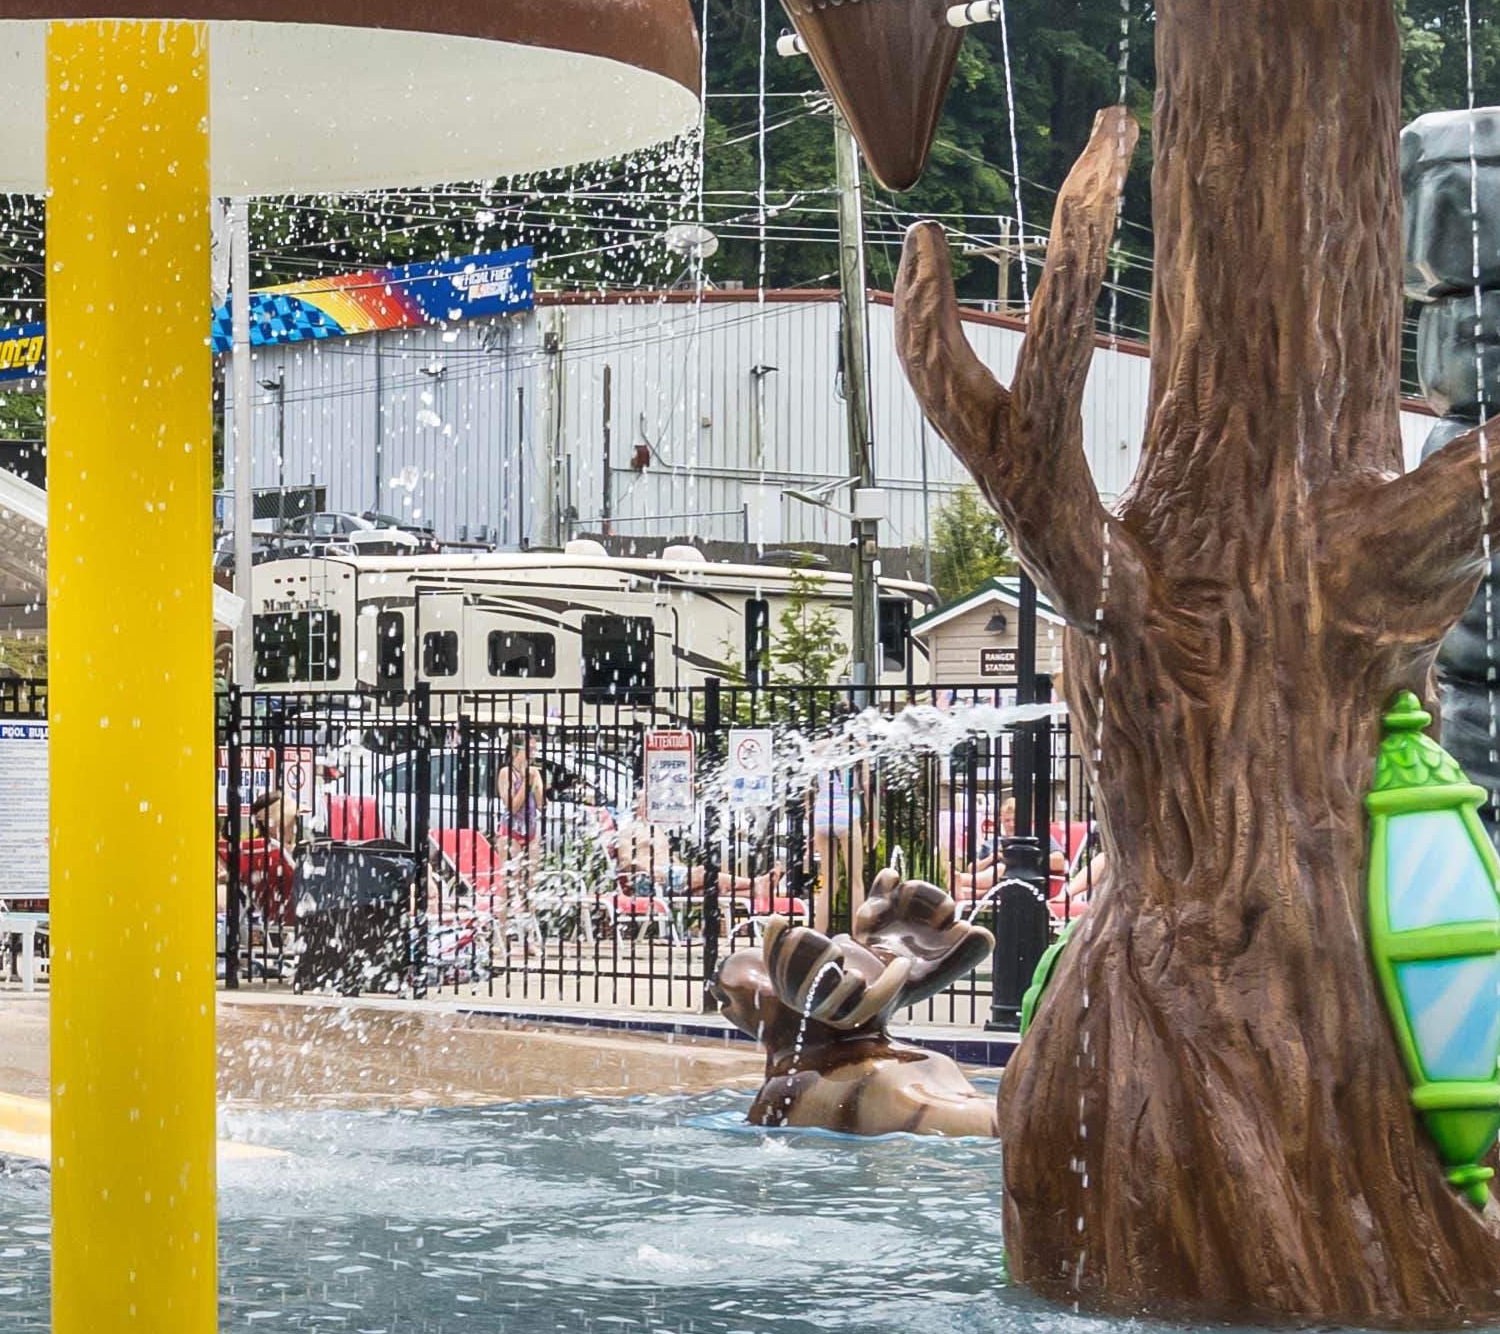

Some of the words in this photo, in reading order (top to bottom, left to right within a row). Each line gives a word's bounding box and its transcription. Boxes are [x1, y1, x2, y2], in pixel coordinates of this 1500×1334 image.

[985, 653, 1015, 661] RANGER
[985, 663, 1015, 672] STATION
[2, 727, 26, 738] POOL
